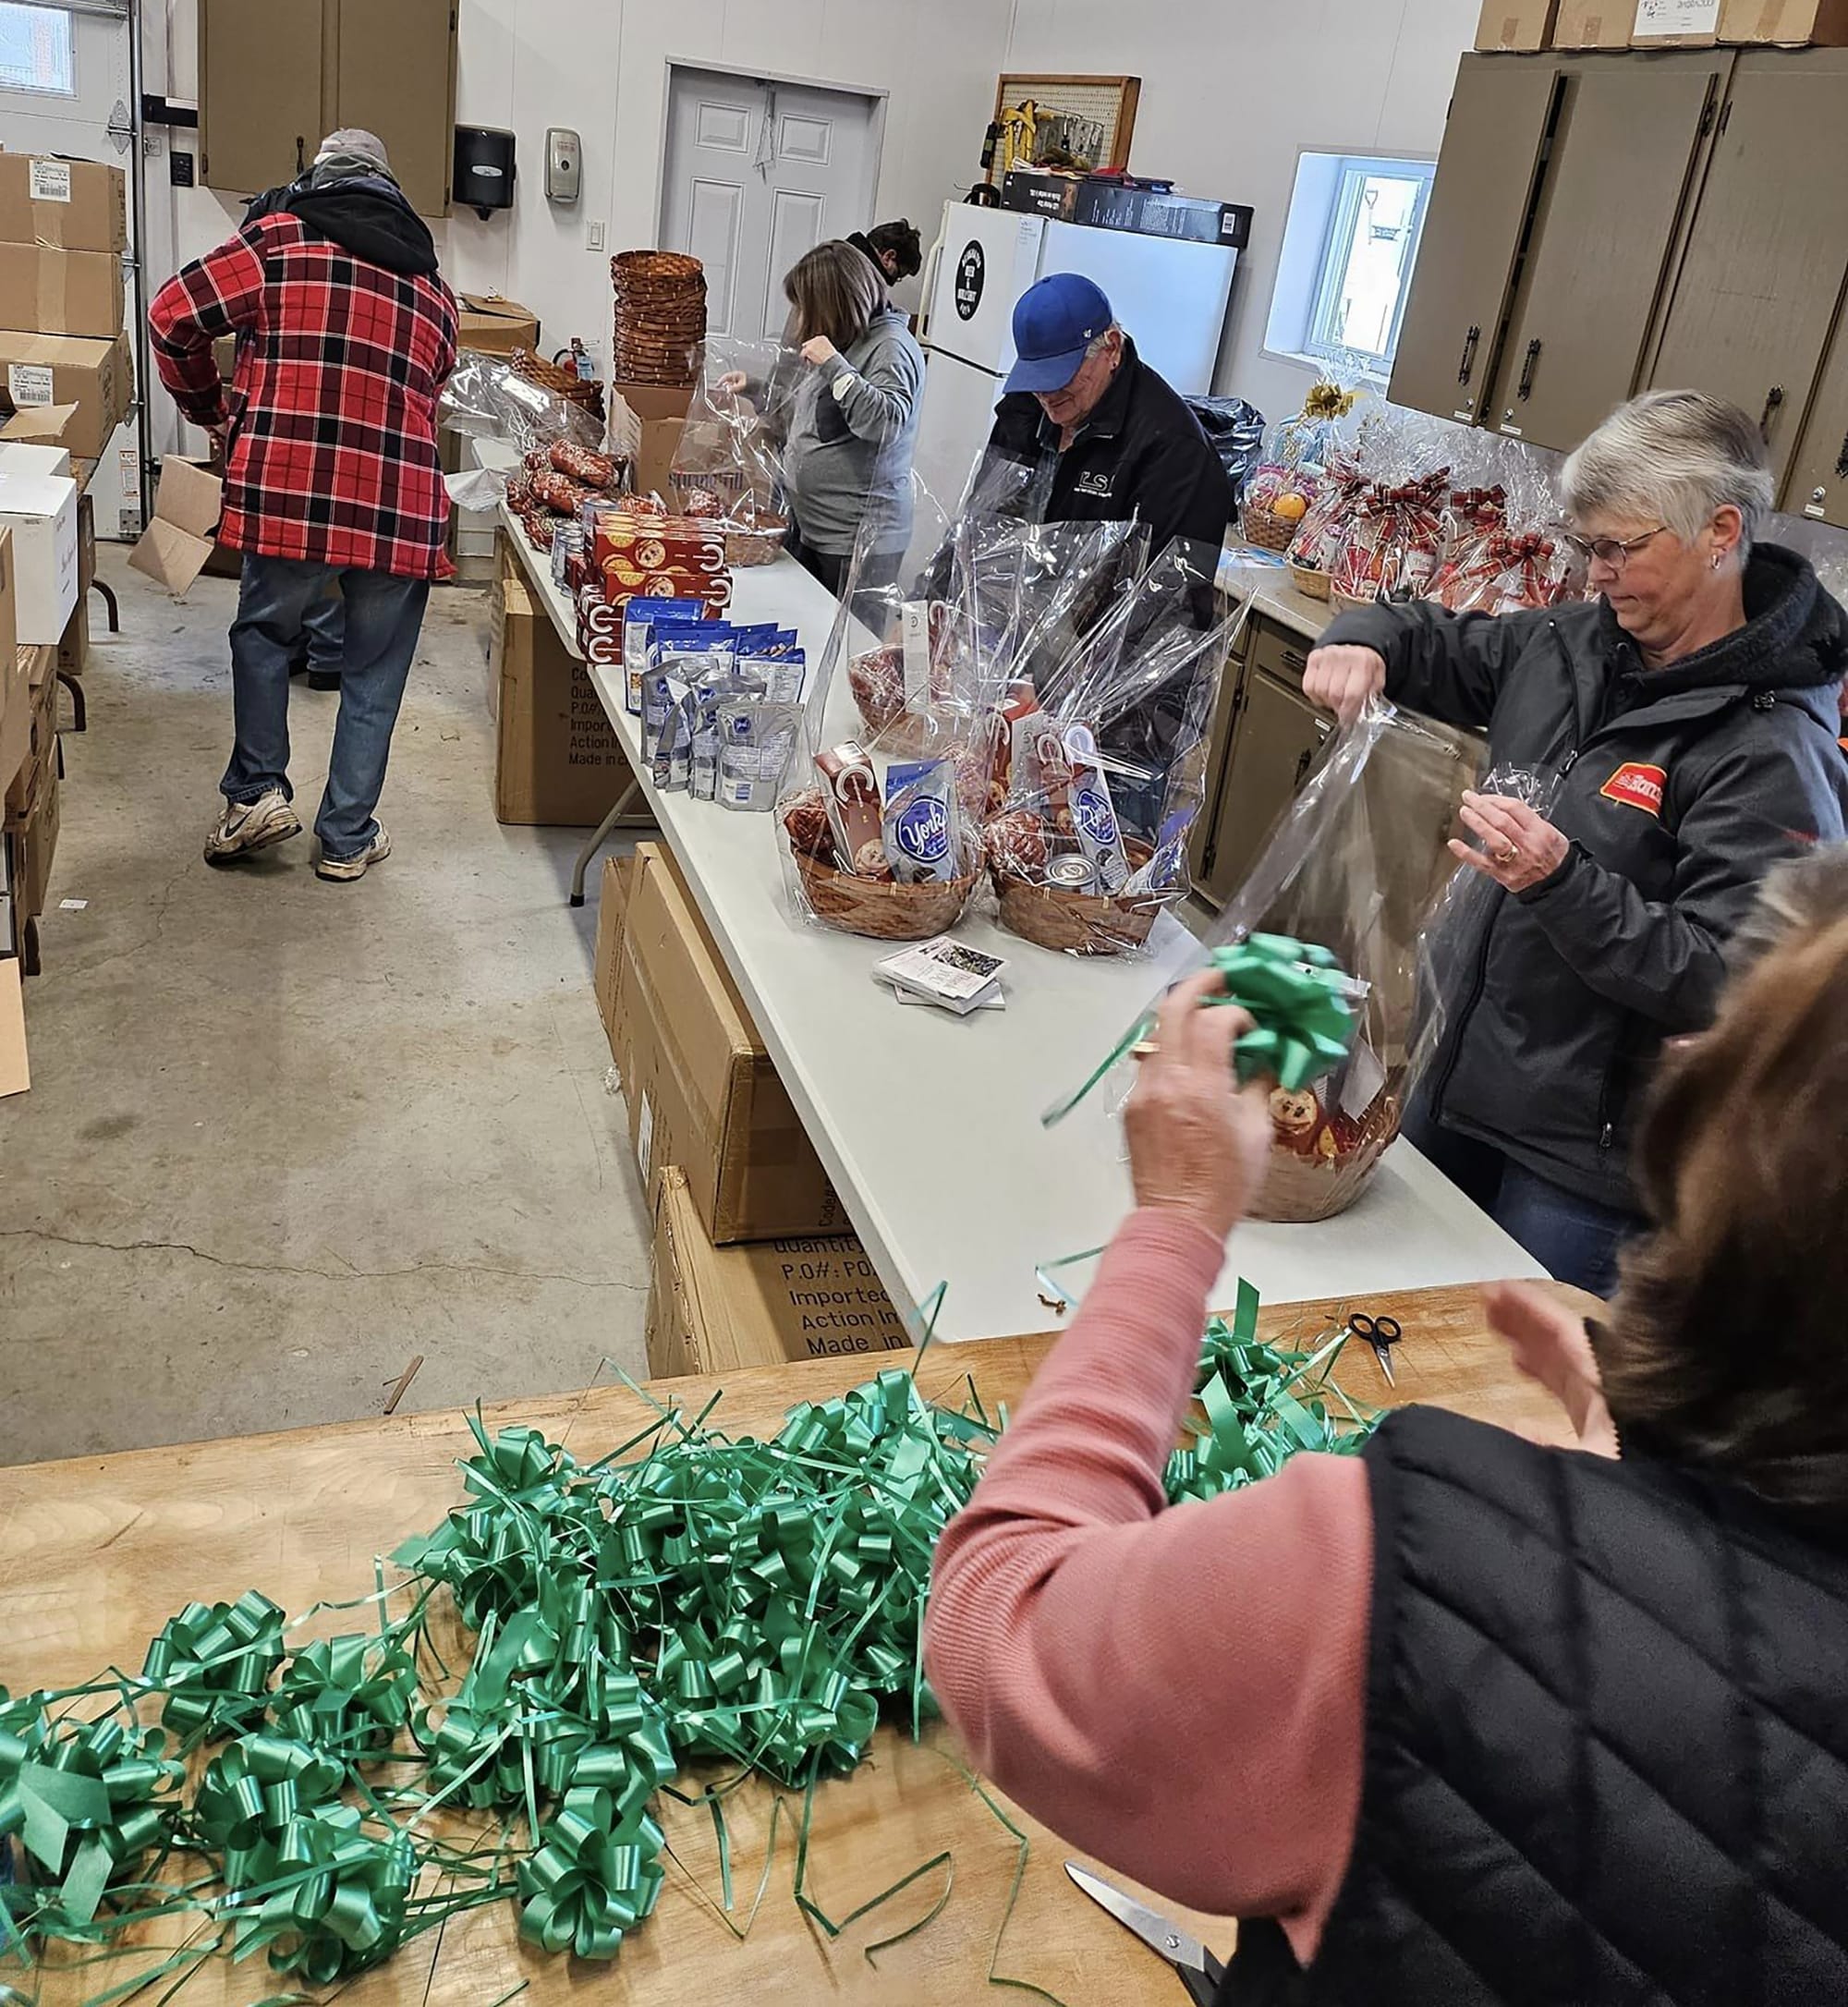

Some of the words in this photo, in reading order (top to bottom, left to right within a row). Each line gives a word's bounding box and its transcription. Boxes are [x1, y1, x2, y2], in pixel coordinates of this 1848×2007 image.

[571, 719, 612, 733] Impor
[570, 736, 610, 749] Action
[569, 752, 602, 765] Made
[902, 803, 946, 855] York
[802, 1310, 874, 1331] Action
[806, 1334, 869, 1356] Made
[881, 1333, 904, 1350] in
